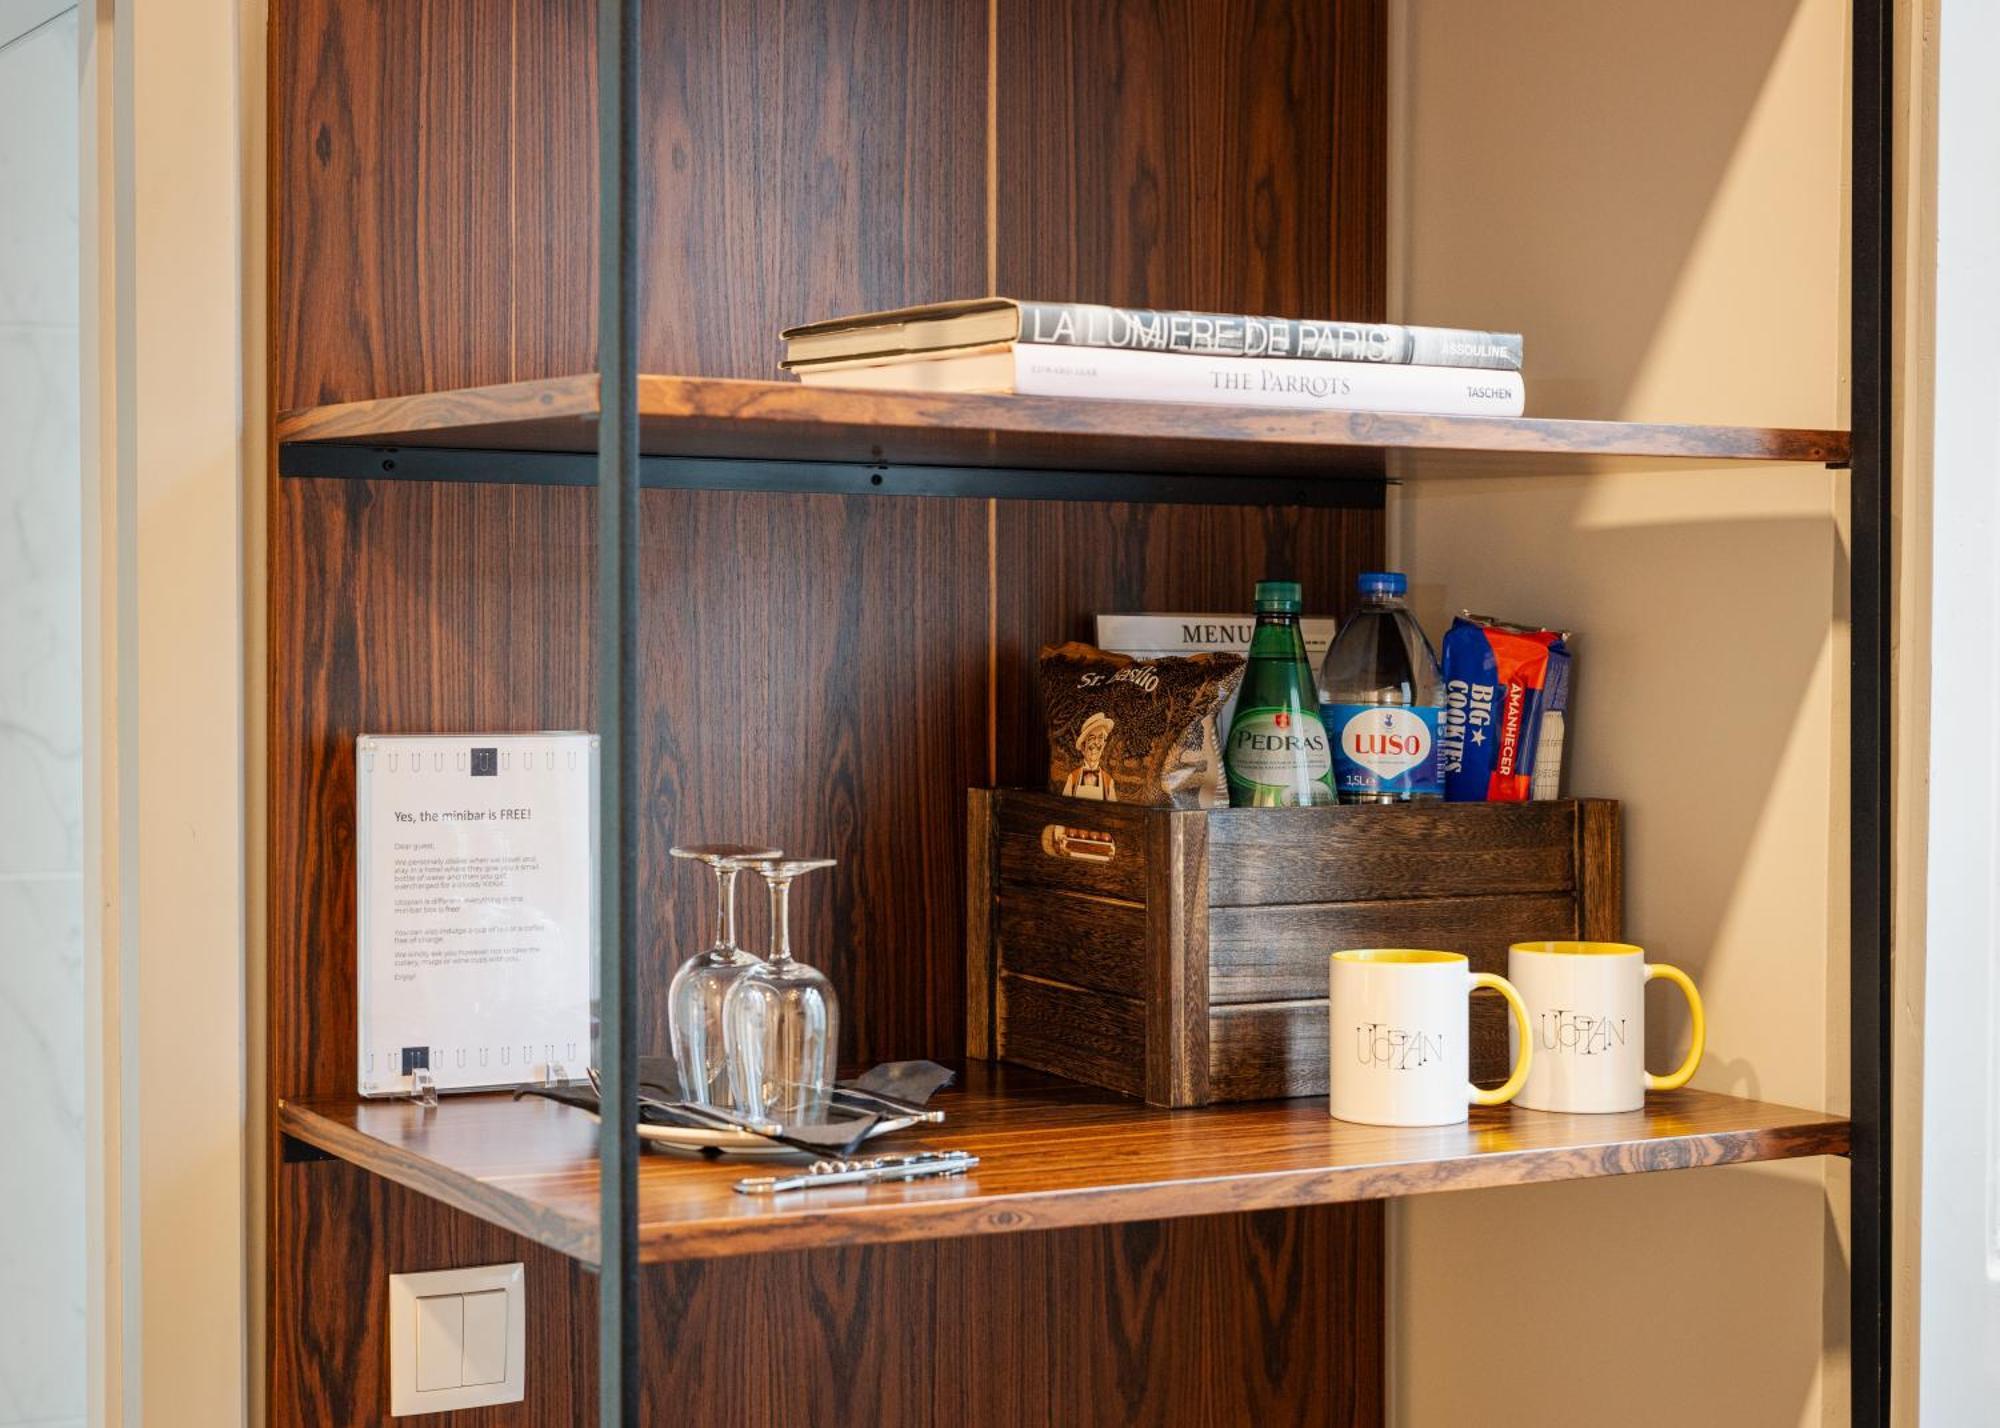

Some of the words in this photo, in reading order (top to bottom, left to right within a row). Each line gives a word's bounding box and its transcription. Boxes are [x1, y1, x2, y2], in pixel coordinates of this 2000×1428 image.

[1033, 308, 1076, 344] LA
[1087, 309, 1236, 355] LUMIERE
[1245, 316, 1290, 356] DE
[1297, 324, 1389, 362] PARIS
[1441, 342, 1509, 359] ASSOULINE
[1210, 370, 1252, 391] THE
[1261, 369, 1351, 398] PARROTS
[1467, 386, 1512, 400] TASCHEN
[1182, 624, 1250, 644] MENU
[1469, 683, 1494, 727] BIG
[1444, 679, 1469, 773] COOKIES
[1500, 683, 1524, 776] AMANHECER
[1236, 730, 1324, 751] PEDRAS
[1355, 734, 1420, 756] LUSO
[394, 810, 416, 824] Yes,
[420, 810, 439, 822] the
[442, 809, 485, 822] minibar
[488, 808, 497, 820] is
[500, 808, 532, 820] FREE!
